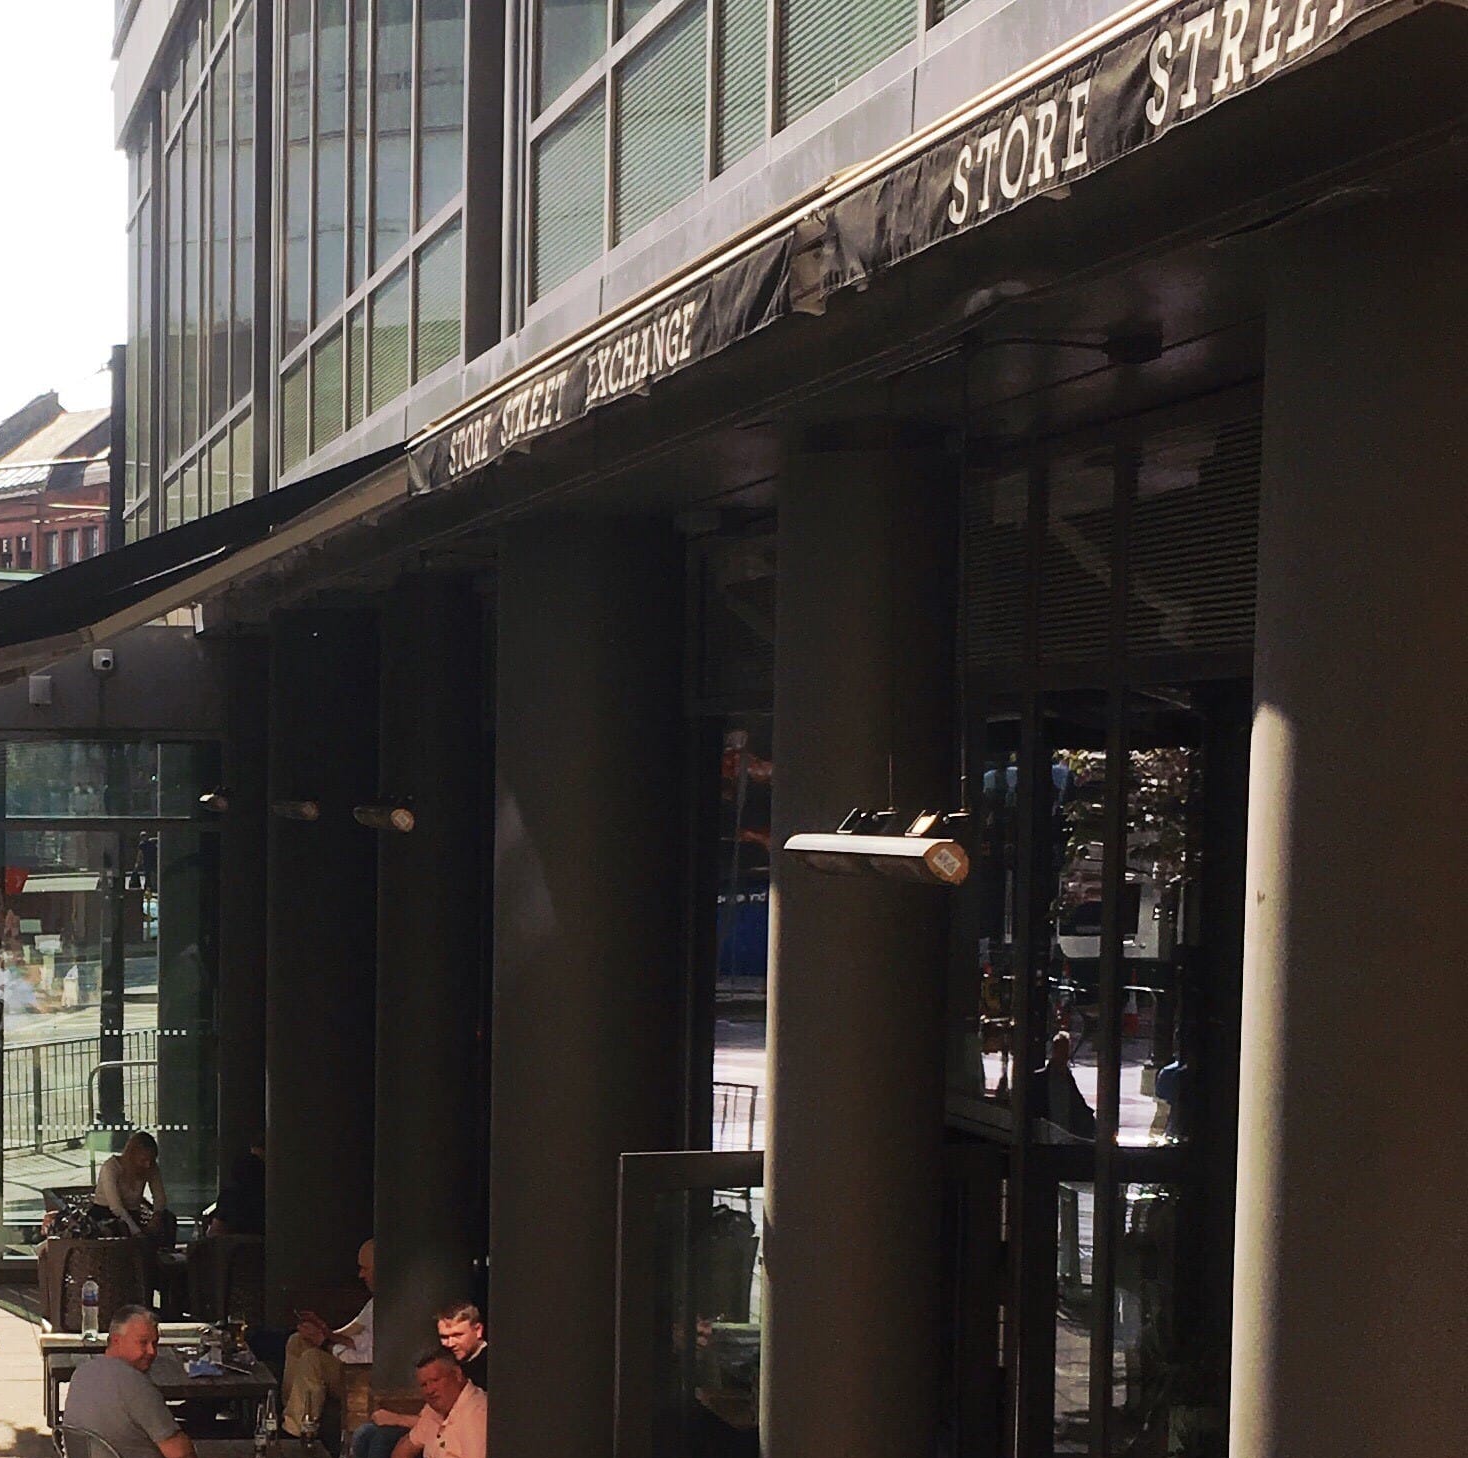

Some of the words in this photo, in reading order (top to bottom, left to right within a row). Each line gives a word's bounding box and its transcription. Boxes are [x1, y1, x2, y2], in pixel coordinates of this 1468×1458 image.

[948, 79, 1092, 225] STORE
[449, 413, 492, 476] STORE
[499, 370, 569, 447] STREET
[585, 301, 696, 404] EXCHANGE
